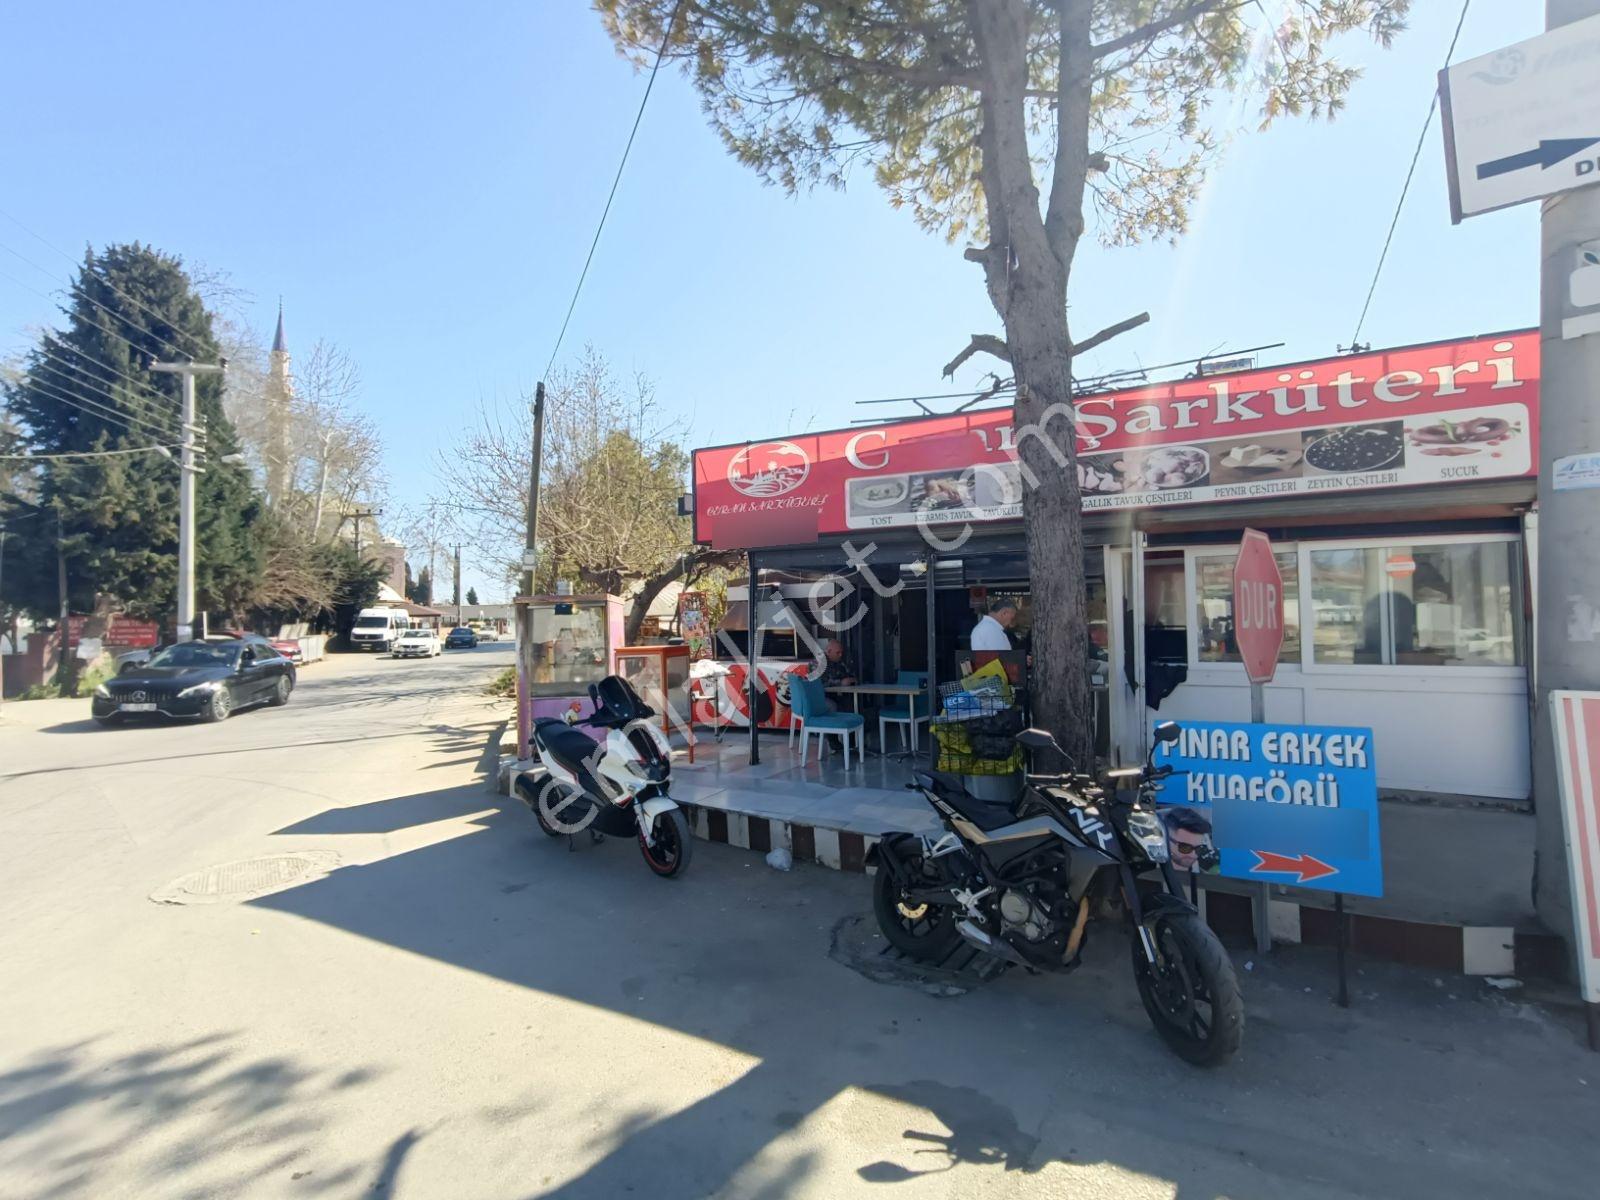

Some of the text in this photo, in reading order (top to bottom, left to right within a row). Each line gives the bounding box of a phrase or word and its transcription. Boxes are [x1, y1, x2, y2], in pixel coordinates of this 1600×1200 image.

[1074, 341, 1524, 450] Şarküteri
[1440, 465, 1480, 478] SUCUK
[1114, 495, 1143, 506] TAVUK
[870, 516, 893, 526] TOST
[1240, 579, 1278, 630] DUR
[1260, 731, 1368, 769] ERKEK
[1186, 769, 1340, 808] KUAFÖRÜ
